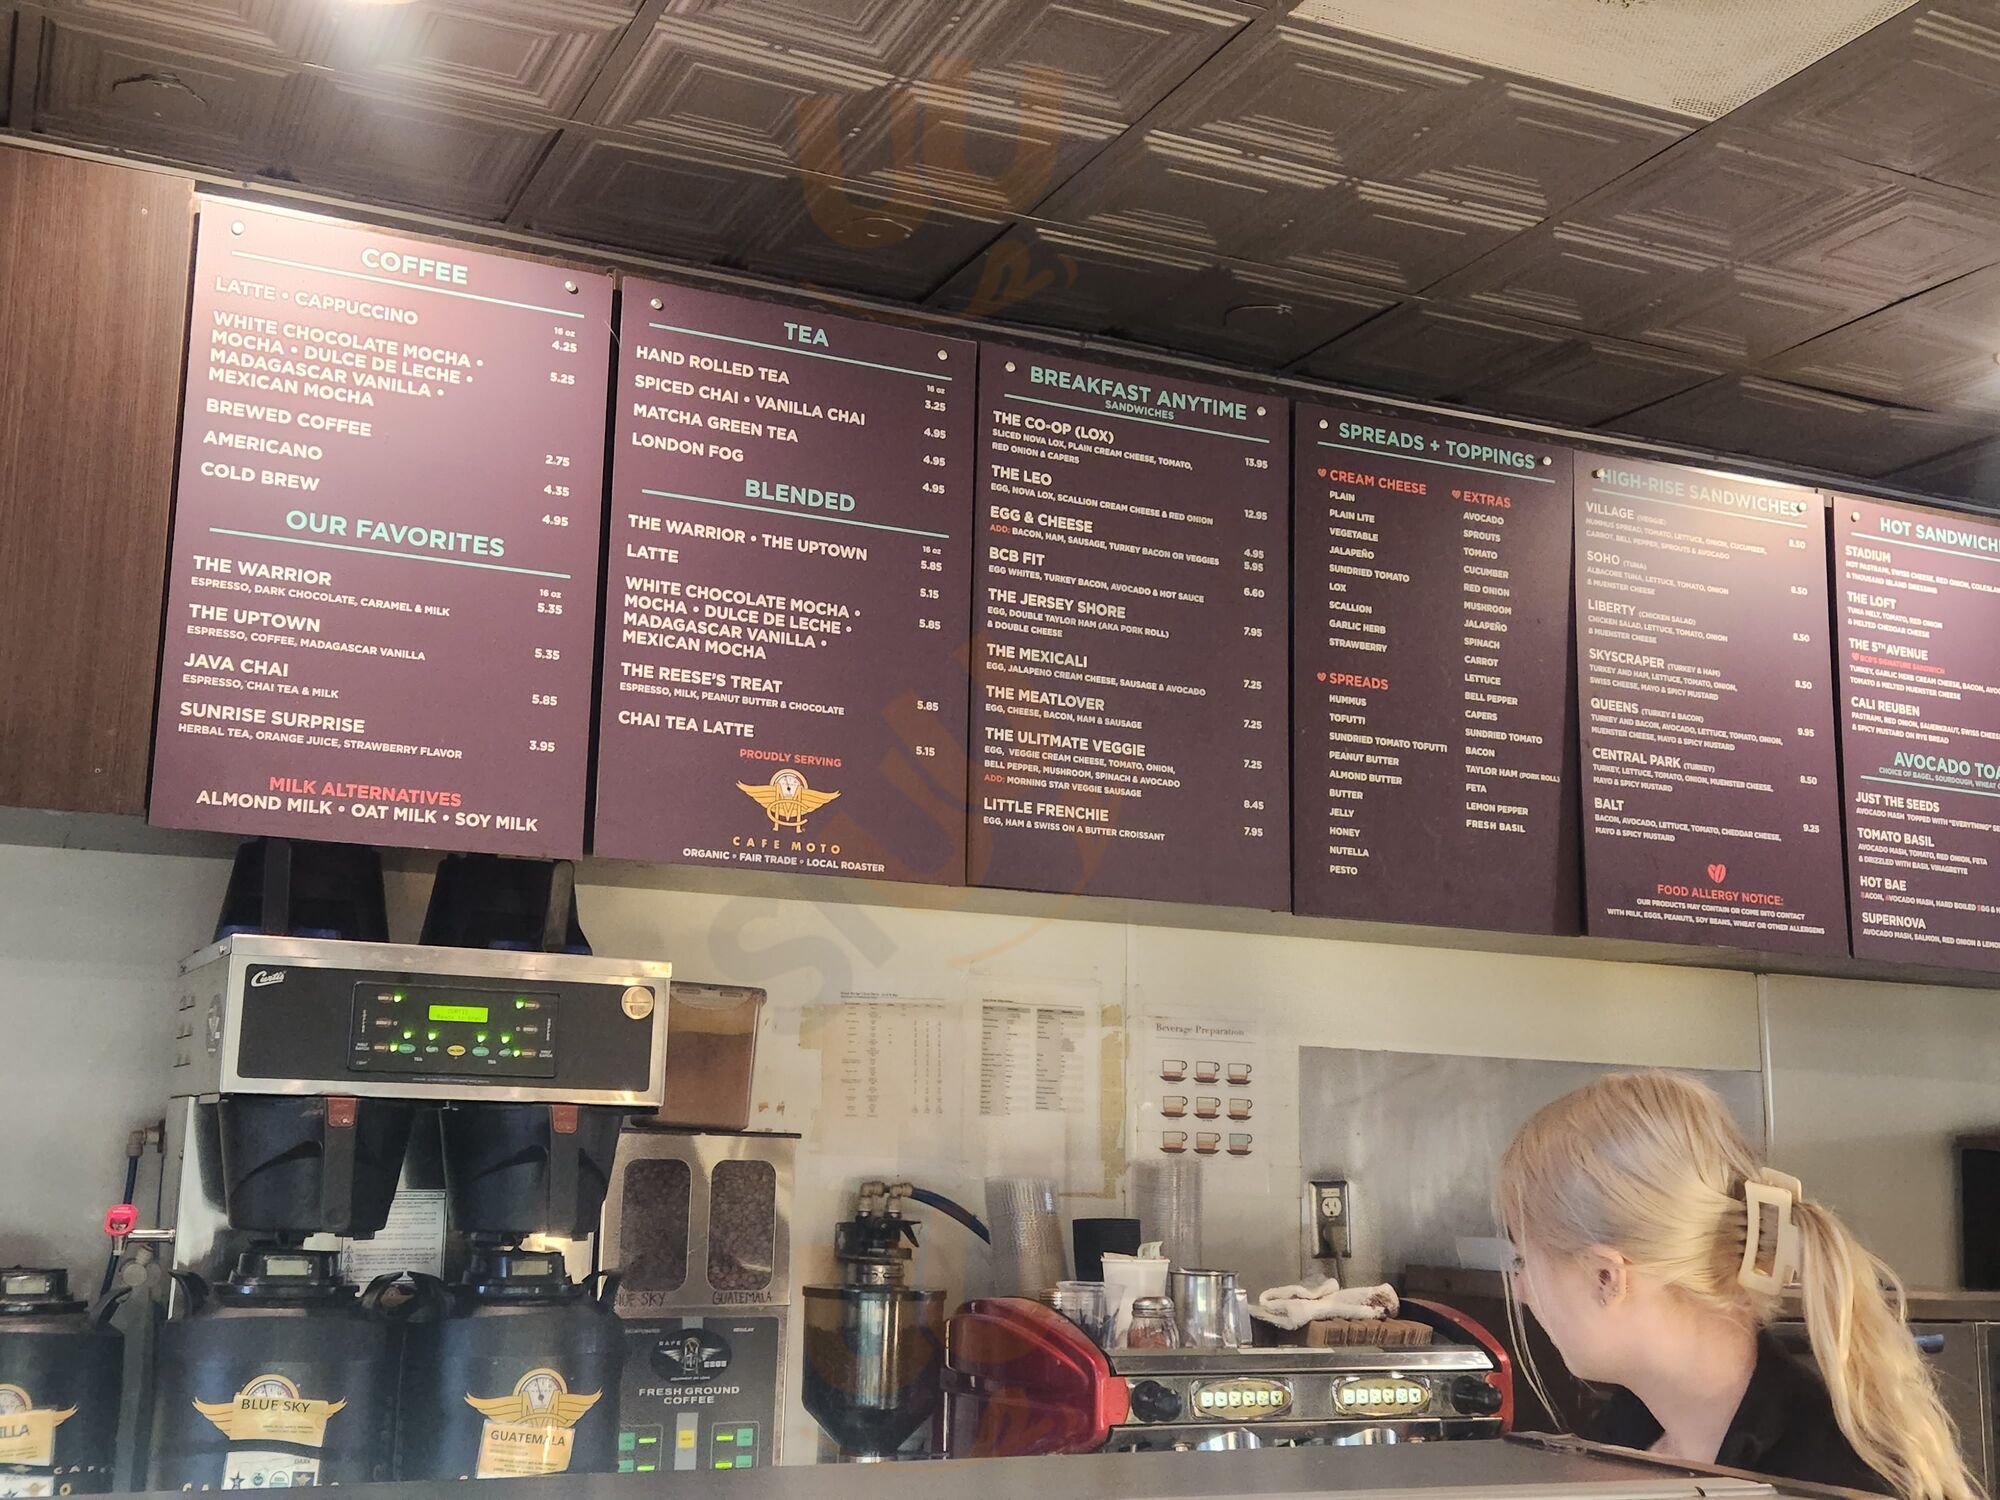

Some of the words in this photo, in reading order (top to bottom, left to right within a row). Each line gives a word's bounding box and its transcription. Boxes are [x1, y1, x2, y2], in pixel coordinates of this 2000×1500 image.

[359, 248, 468, 285] COFFEE
[215, 276, 276, 302] LATTE
[293, 290, 419, 326] CAPPUCCINO
[553, 326, 563, 335] 16
[564, 329, 575, 337] oz
[783, 321, 829, 347] TEA
[551, 339, 577, 353] 4.25
[636, 344, 685, 365] HAND
[689, 354, 754, 377] ROLLED
[757, 366, 789, 384] TEA
[1030, 365, 1151, 403] BREAKFAST
[1156, 390, 1247, 420] ANYTIME
[924, 399, 946, 412] 3.25
[1105, 399, 1174, 420] SANDWICHES
[205, 397, 292, 424] BREWED
[296, 412, 372, 437] COFFEE
[633, 402, 703, 427] MATCHA
[706, 415, 762, 437] GREEN
[766, 425, 798, 443] TEA
[992, 410, 1021, 427] THE
[1024, 416, 1071, 435] CO-OP
[1074, 425, 1114, 444] (LOX)
[202, 429, 323, 460] AMERICANO
[631, 431, 704, 456] LONDON
[708, 444, 744, 462] FOG
[1338, 422, 1424, 451] SPREADS
[1429, 439, 1440, 451] +
[1445, 439, 1535, 469] TOPPINGS
[544, 454, 570, 467] 2.75
[1244, 457, 1268, 469] 13.95
[200, 461, 256, 482] COLD
[260, 469, 320, 491] BREW
[991, 464, 1019, 481] THE
[1023, 469, 1052, 486] LEO
[1329, 469, 1374, 486] CREAM
[1377, 477, 1426, 495] CHEESE
[543, 484, 569, 497] 4.35
[745, 478, 855, 512] BLENDED
[1463, 490, 1511, 508] EXTRAS
[1599, 468, 1685, 497] HIGH-RISE
[1689, 484, 1799, 517] SANDWICHES
[541, 513, 568, 527] 4.95
[990, 505, 1021, 522] EGG
[1023, 510, 1034, 524] &
[1037, 513, 1093, 533] CHEESE
[1244, 508, 1267, 520] 12.95
[1462, 511, 1504, 525] AVOCADO
[1585, 501, 1634, 520] VILLAGE
[286, 510, 347, 536] OUR
[356, 519, 504, 557] FAVORITES
[1880, 516, 1912, 536] HOT
[1915, 523, 2000, 552] SANDWICH
[626, 543, 679, 563] LATTE
[989, 546, 1019, 562] BCB
[1022, 551, 1045, 566] FIT
[1844, 544, 1891, 563] STADIUM
[192, 554, 232, 573] THE
[237, 560, 332, 586] WARRIOR
[190, 576, 252, 594] ESPRESSO,
[253, 583, 286, 596] DARK
[287, 588, 358, 607] CHOCOLATE,
[359, 597, 413, 612] CARAMEL
[414, 603, 422, 613] &
[423, 605, 450, 617] MILK
[919, 587, 939, 599] 5.15
[1243, 587, 1265, 598] 6.60
[1328, 581, 1346, 592] LOX
[1587, 598, 1636, 616] LIBERTY
[1846, 590, 1868, 605] THE
[1869, 594, 1897, 610] LOFT
[188, 603, 228, 622] THE
[233, 608, 320, 632] UPTOWN
[986, 642, 1015, 658] THE
[1018, 647, 1087, 668] MEXICALI
[1588, 647, 1664, 669] SKYSCRAPER
[620, 661, 654, 679] THE
[730, 674, 783, 693] TREAT
[1329, 672, 1388, 690] SPREADS
[619, 681, 672, 697] ESPRESSO,
[673, 687, 699, 700] MILK,
[701, 690, 740, 703] PEANUT
[741, 695, 778, 708] BUTTER
[779, 700, 787, 709] &
[788, 701, 844, 715] CHOCOLATE
[985, 684, 1014, 700] THE
[1018, 688, 1104, 711] MEATLOVER
[1590, 697, 1639, 714] QUEENS
[1850, 695, 1875, 710] CALI
[1877, 699, 1920, 717] REUBEN
[179, 701, 266, 724] SUNRISE
[270, 710, 365, 734] SURPRISE
[528, 739, 555, 752] 3.95
[984, 726, 1014, 742] THE
[1017, 730, 1088, 750] ULITMATE
[1092, 739, 1145, 757] VEGGIE
[739, 748, 791, 762] PROUDLY
[793, 753, 841, 767] SERVING
[1591, 746, 1647, 764] CENTRAL
[1649, 753, 1681, 769] PARK
[1893, 751, 1970, 776] AVOCADO
[269, 776, 316, 794] MILK
[321, 781, 461, 807] ALTERNATIVES
[1328, 788, 1363, 799] BUTTER
[1855, 791, 1881, 805] JUST
[1882, 794, 1905, 808] THE
[1905, 797, 1940, 813] SEEDS
[195, 789, 282, 810] ALMOND
[286, 797, 332, 815] MILK
[350, 803, 389, 819] OAT
[393, 806, 437, 823] MILK
[454, 811, 492, 828] SOY
[495, 815, 538, 832] MILK
[983, 797, 1032, 814] LITTLE
[1036, 802, 1109, 822] FRENCHIE
[1243, 799, 1264, 810] 8.45
[1594, 796, 1624, 811] BALT
[1329, 826, 1360, 837] HONEY
[1465, 818, 1497, 830] FRESH
[1498, 822, 1526, 833] BASIL
[732, 836, 780, 849] CAFE
[790, 841, 840, 854] MOTO
[1856, 826, 1902, 843] TOMATO
[1903, 832, 1935, 847] BASIL
[682, 847, 730, 860] ORGANIC
[739, 852, 762, 862] FAIR
[763, 854, 797, 865] TRADE
[806, 857, 839, 869] LOCAL
[840, 860, 885, 872] ROASTER
[1329, 845, 1369, 857] NUTELLA
[1329, 864, 1358, 875] PESTO
[1859, 875, 1882, 888] HOT
[1883, 877, 1907, 891] BAE
[1657, 883, 1689, 896] FOOD
[1691, 887, 1739, 901] ALLERGY
[1741, 892, 1783, 905] NOTICE:
[1861, 911, 1926, 929] SUPERNOVA
[250, 970, 285, 987] Curtis
[1156, 1023, 1192, 1034] Beverage
[1195, 1025, 1245, 1037] Preparation
[641, 1291, 666, 1307] SKY
[638, 1388, 682, 1397] FRESH
[685, 1386, 740, 1395] GROUND
[663, 1396, 715, 1405] COFFEE
[241, 1398, 279, 1411] BLUE
[283, 1400, 311, 1413] SKY
